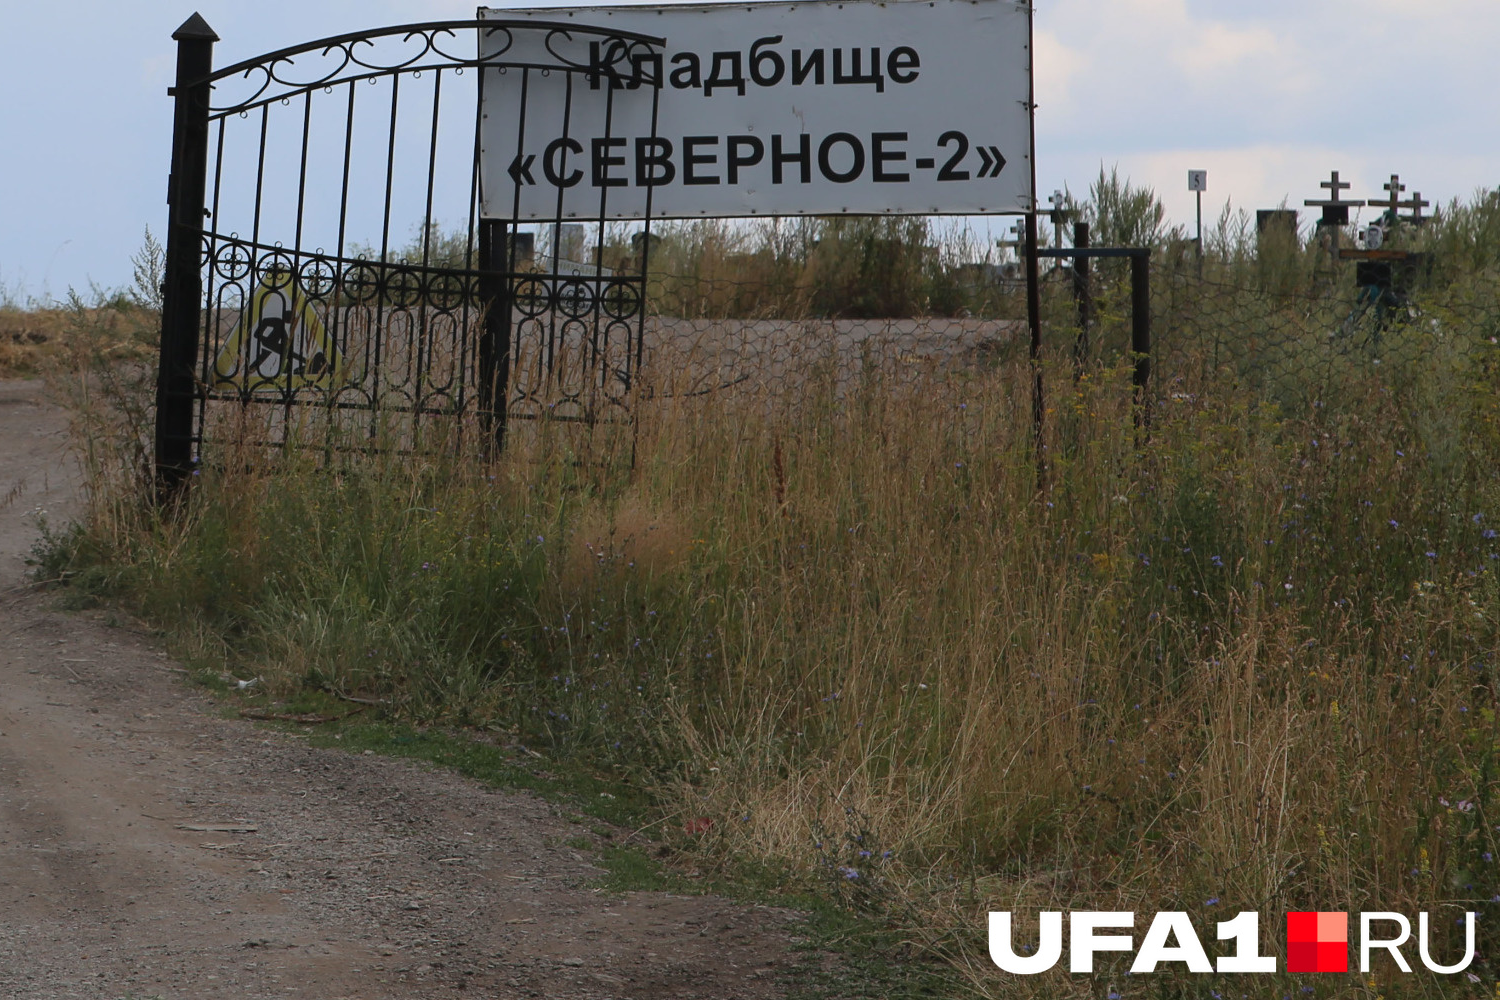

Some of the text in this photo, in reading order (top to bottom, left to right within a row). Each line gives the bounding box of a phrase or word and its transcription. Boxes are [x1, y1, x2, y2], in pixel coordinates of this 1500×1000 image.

[588, 35, 921, 96] Кладбище
[507, 130, 1007, 188] «СЕВЕРНОЕ-2»
[1194, 174, 1200, 188] 5
